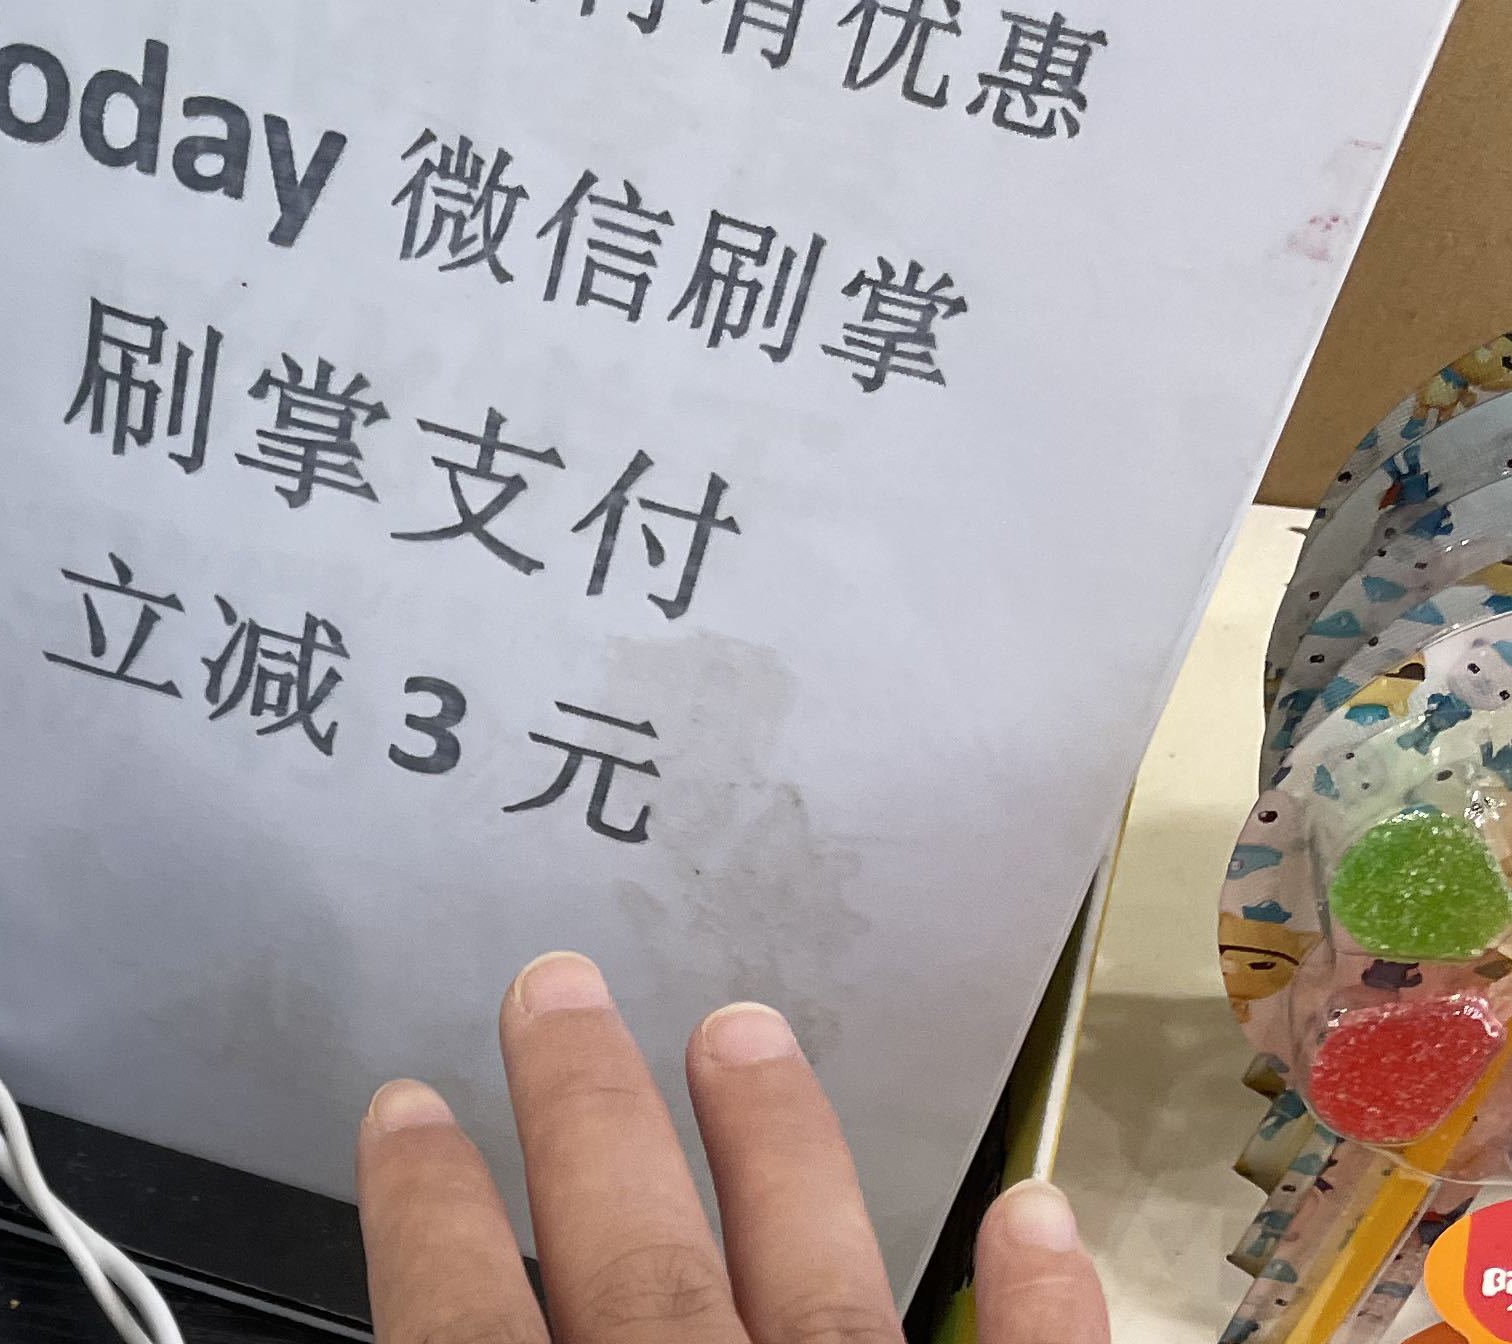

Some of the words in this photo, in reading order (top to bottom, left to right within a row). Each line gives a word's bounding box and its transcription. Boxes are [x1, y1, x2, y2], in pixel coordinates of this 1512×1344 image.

[580, 0, 1108, 140] 有优惠
[392, 129, 969, 393] 微信刷掌
[64, 298, 742, 620] 刷掌支付
[43, 552, 351, 757] 立减
[387, 675, 468, 776] 3
[502, 699, 663, 845] 元
